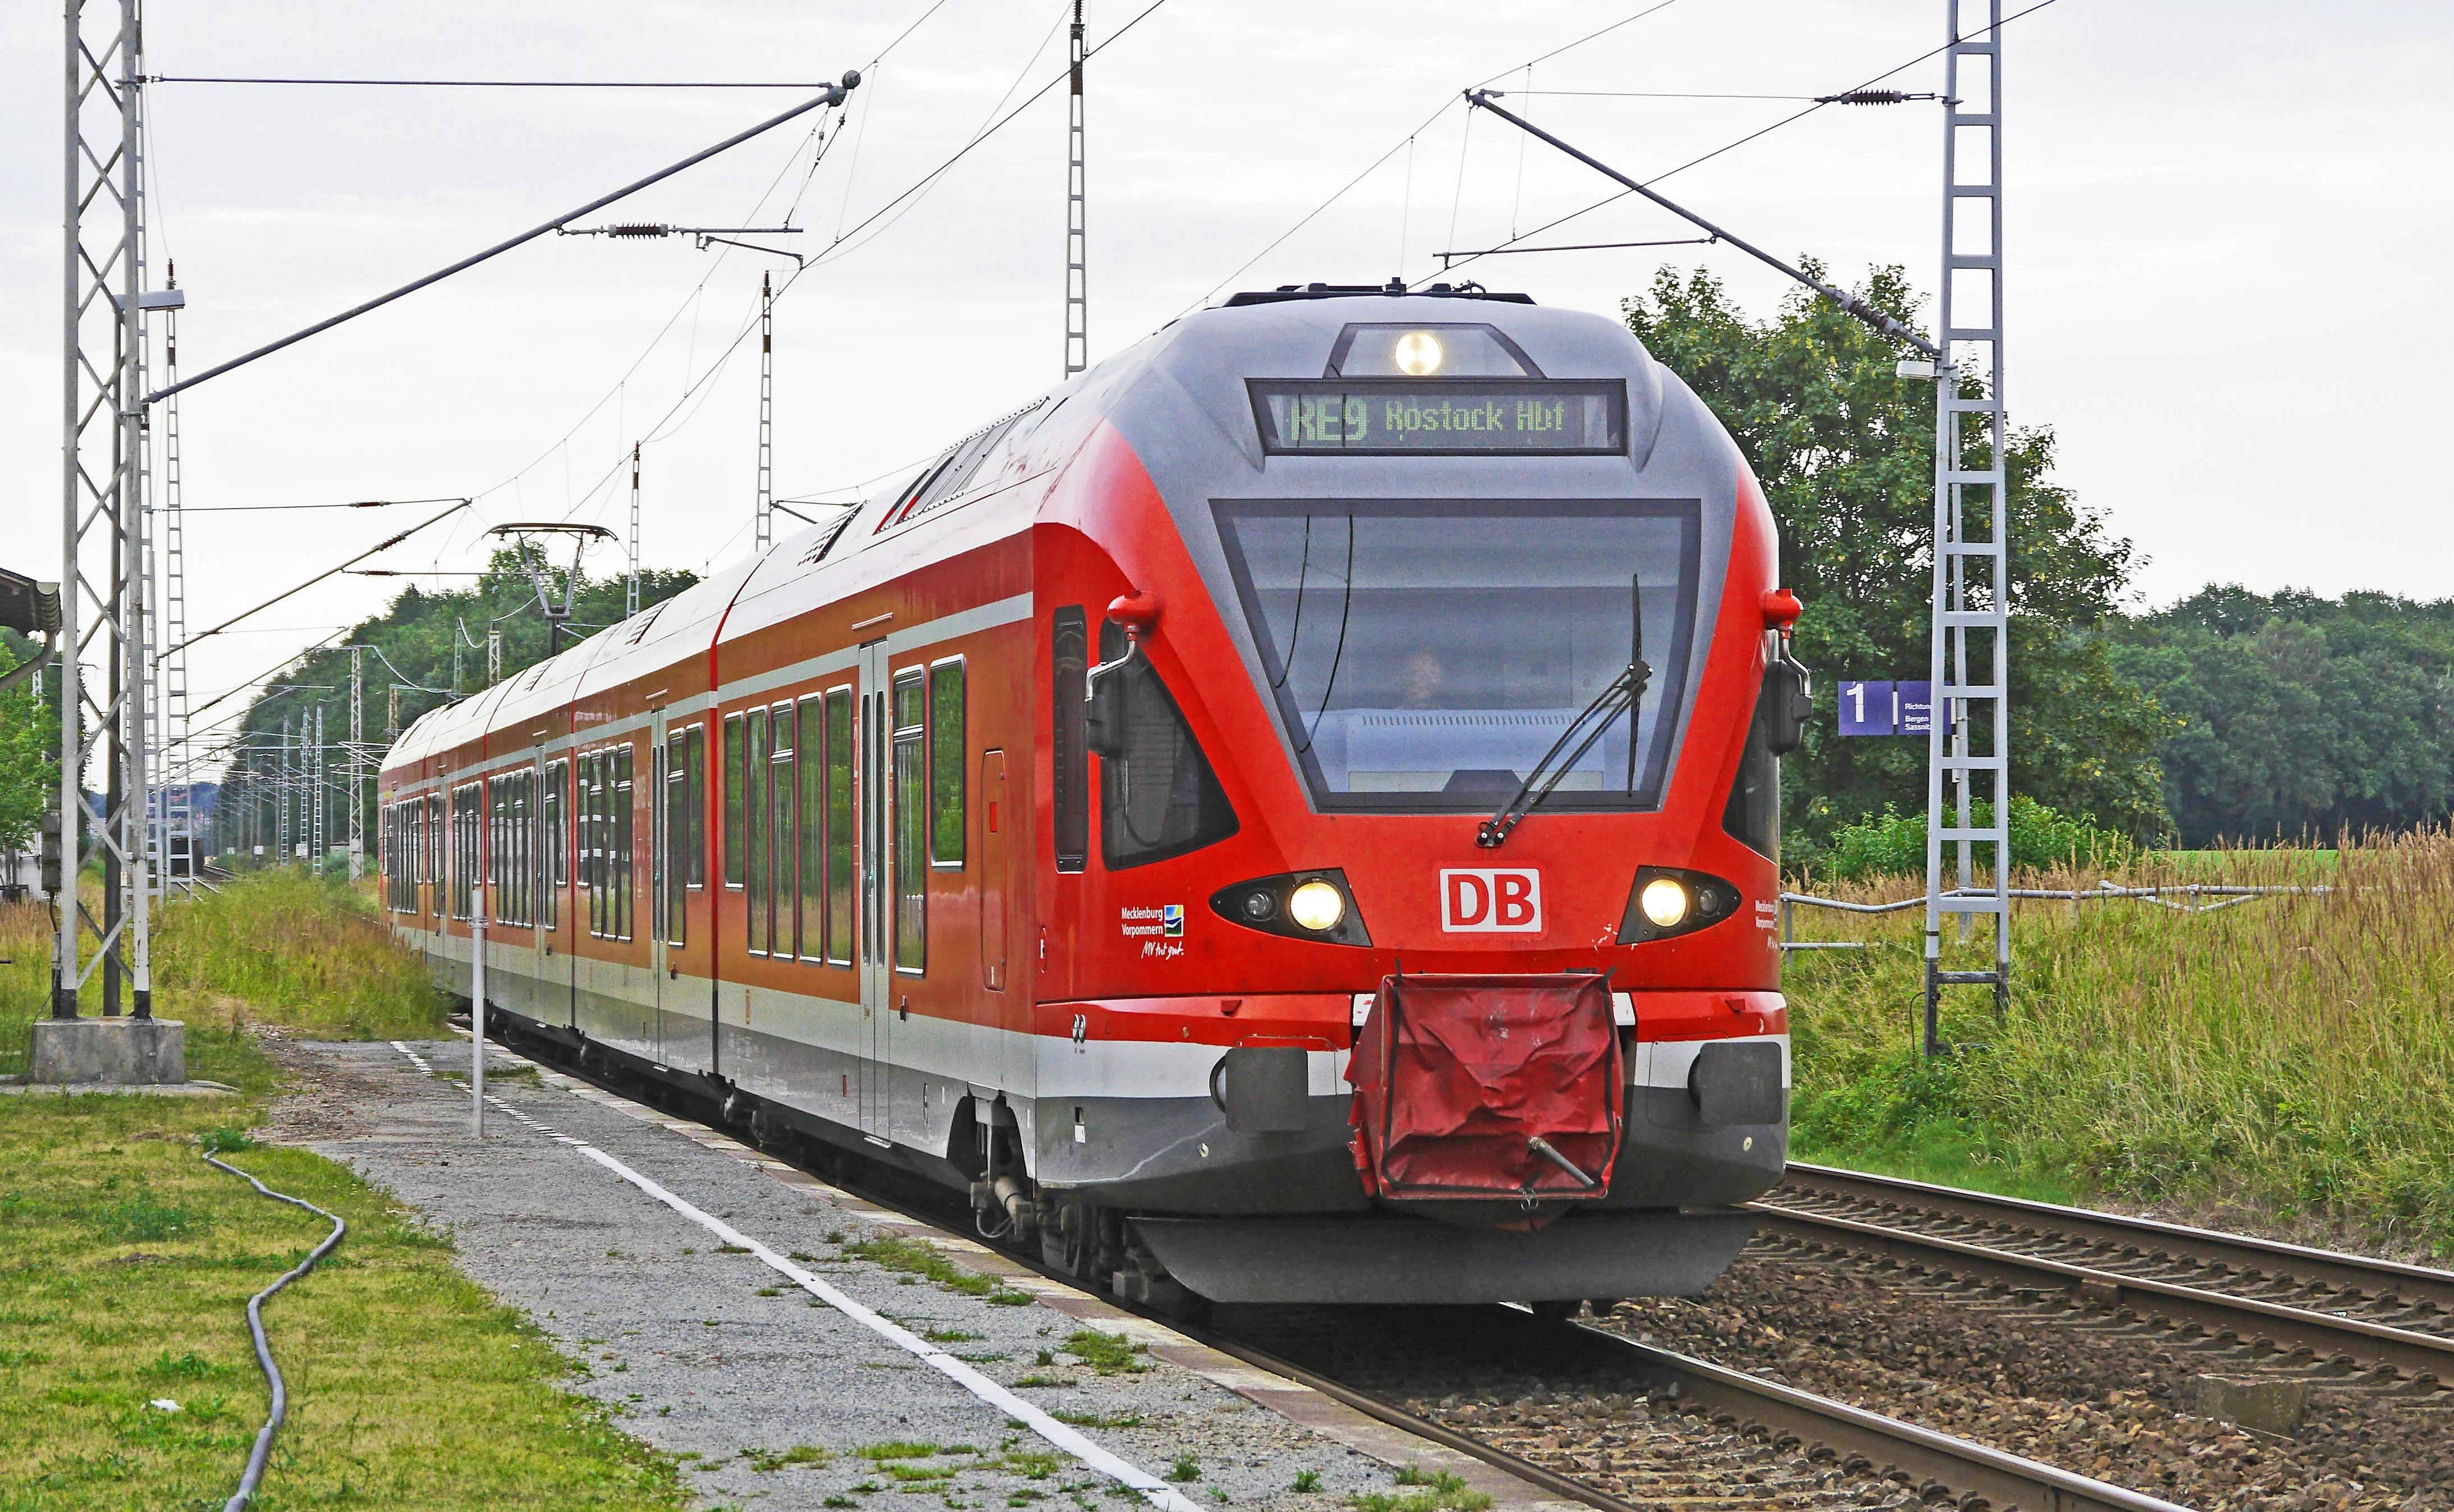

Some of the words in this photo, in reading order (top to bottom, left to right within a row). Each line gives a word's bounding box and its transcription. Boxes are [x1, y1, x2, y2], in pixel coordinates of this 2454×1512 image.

[1291, 398, 1367, 441] RE9
[1386, 401, 1503, 430] Rostock
[1846, 683, 1864, 723] 1
[1904, 715, 1929, 723] Bergen
[1448, 873, 1535, 926] DB
[1121, 906, 1163, 922] Mecklenburg
[1121, 923, 1164, 938] Vorpommern
